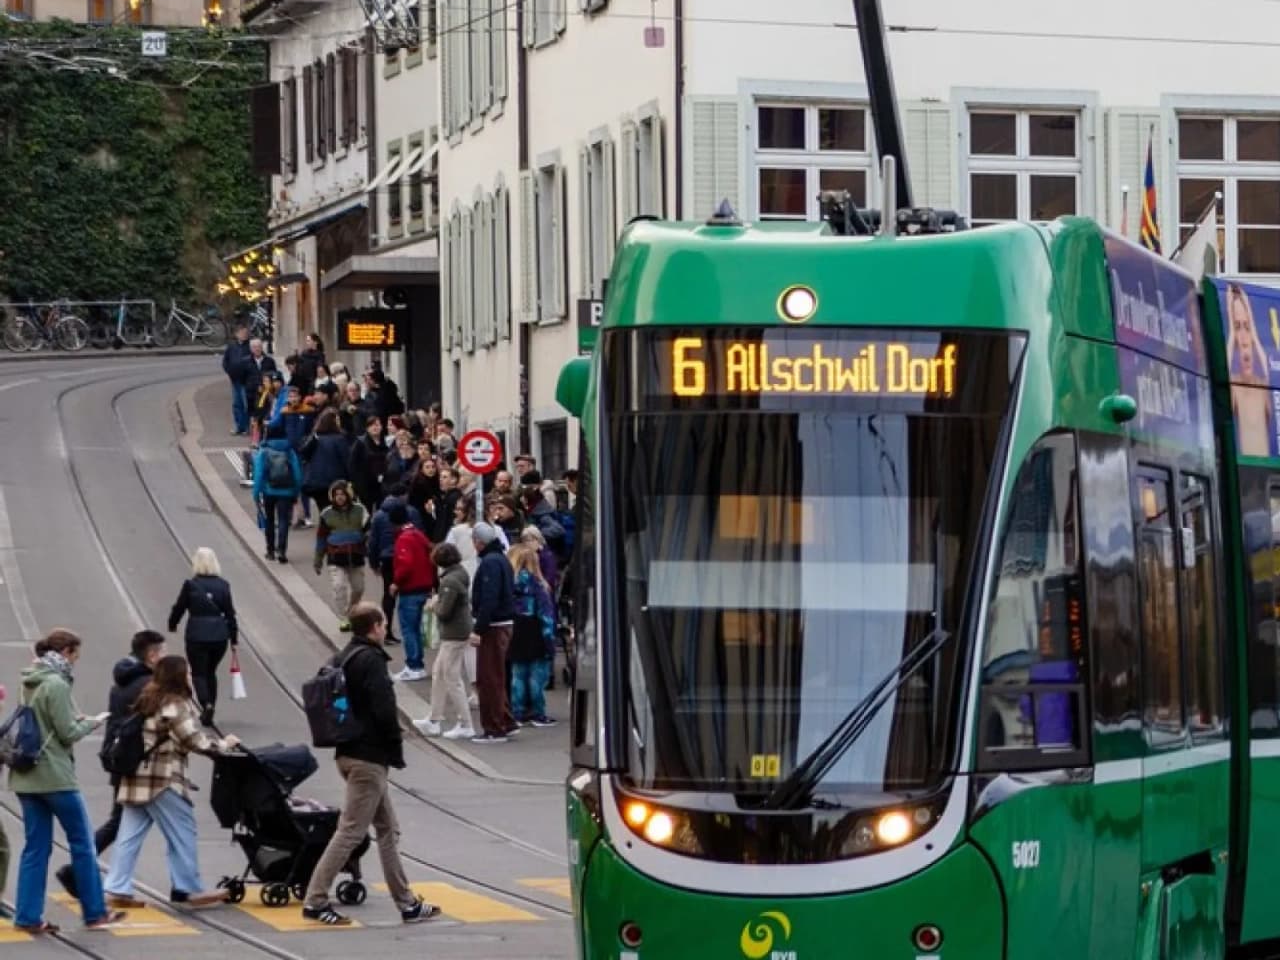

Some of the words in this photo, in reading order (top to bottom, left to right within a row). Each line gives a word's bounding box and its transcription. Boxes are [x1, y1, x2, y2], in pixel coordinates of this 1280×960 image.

[145, 36, 164, 51] 20
[672, 337, 706, 396] 6
[726, 343, 879, 393] Allschwil
[887, 343, 957, 395] Dorf
[1012, 840, 1041, 868] 5027
